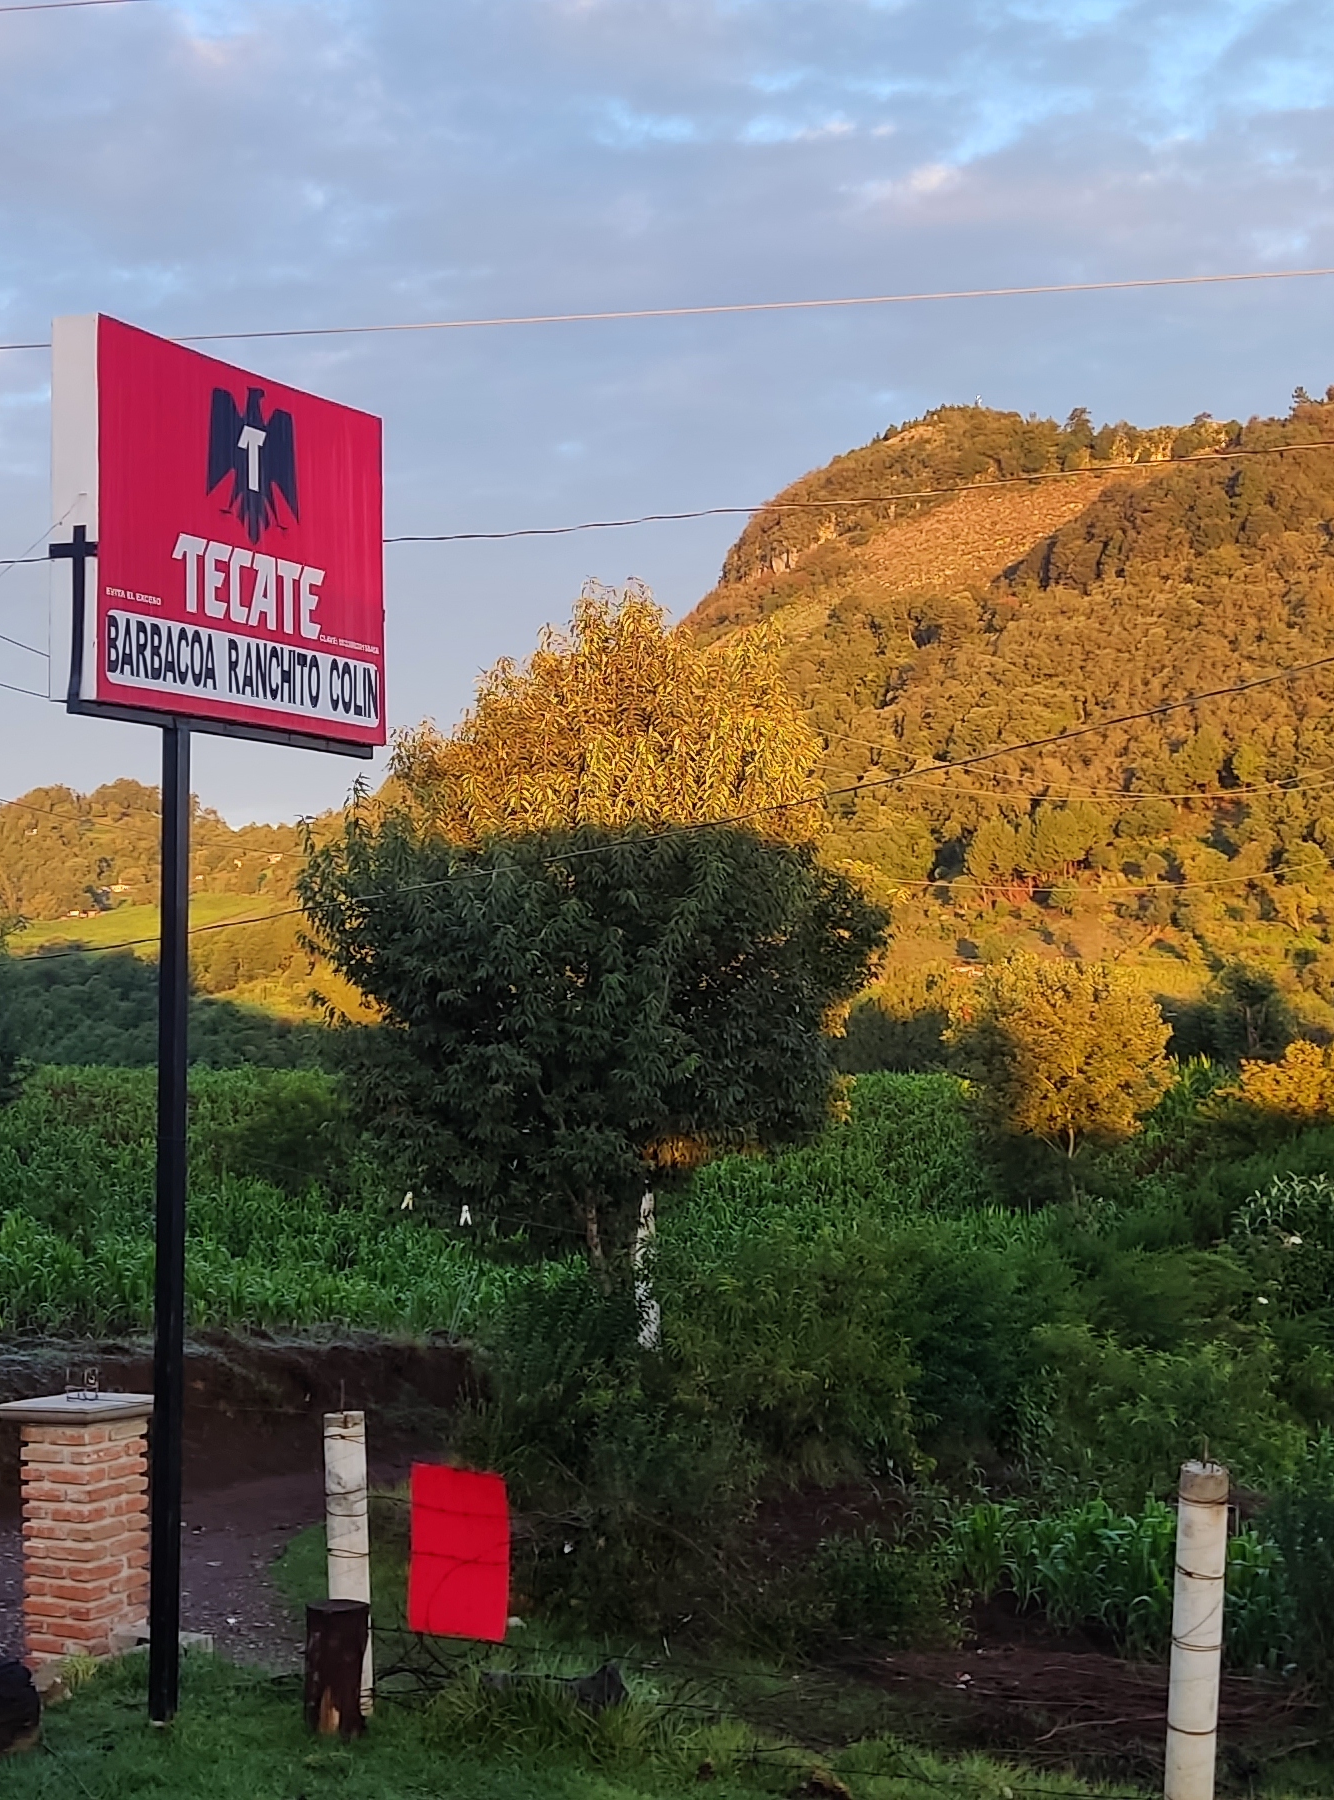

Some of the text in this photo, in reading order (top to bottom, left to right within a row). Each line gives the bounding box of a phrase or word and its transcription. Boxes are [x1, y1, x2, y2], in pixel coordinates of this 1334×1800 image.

[238, 425, 267, 492] T
[172, 533, 326, 640] TECATE
[107, 614, 379, 720] BARBACOA RANCHITO COLIN
